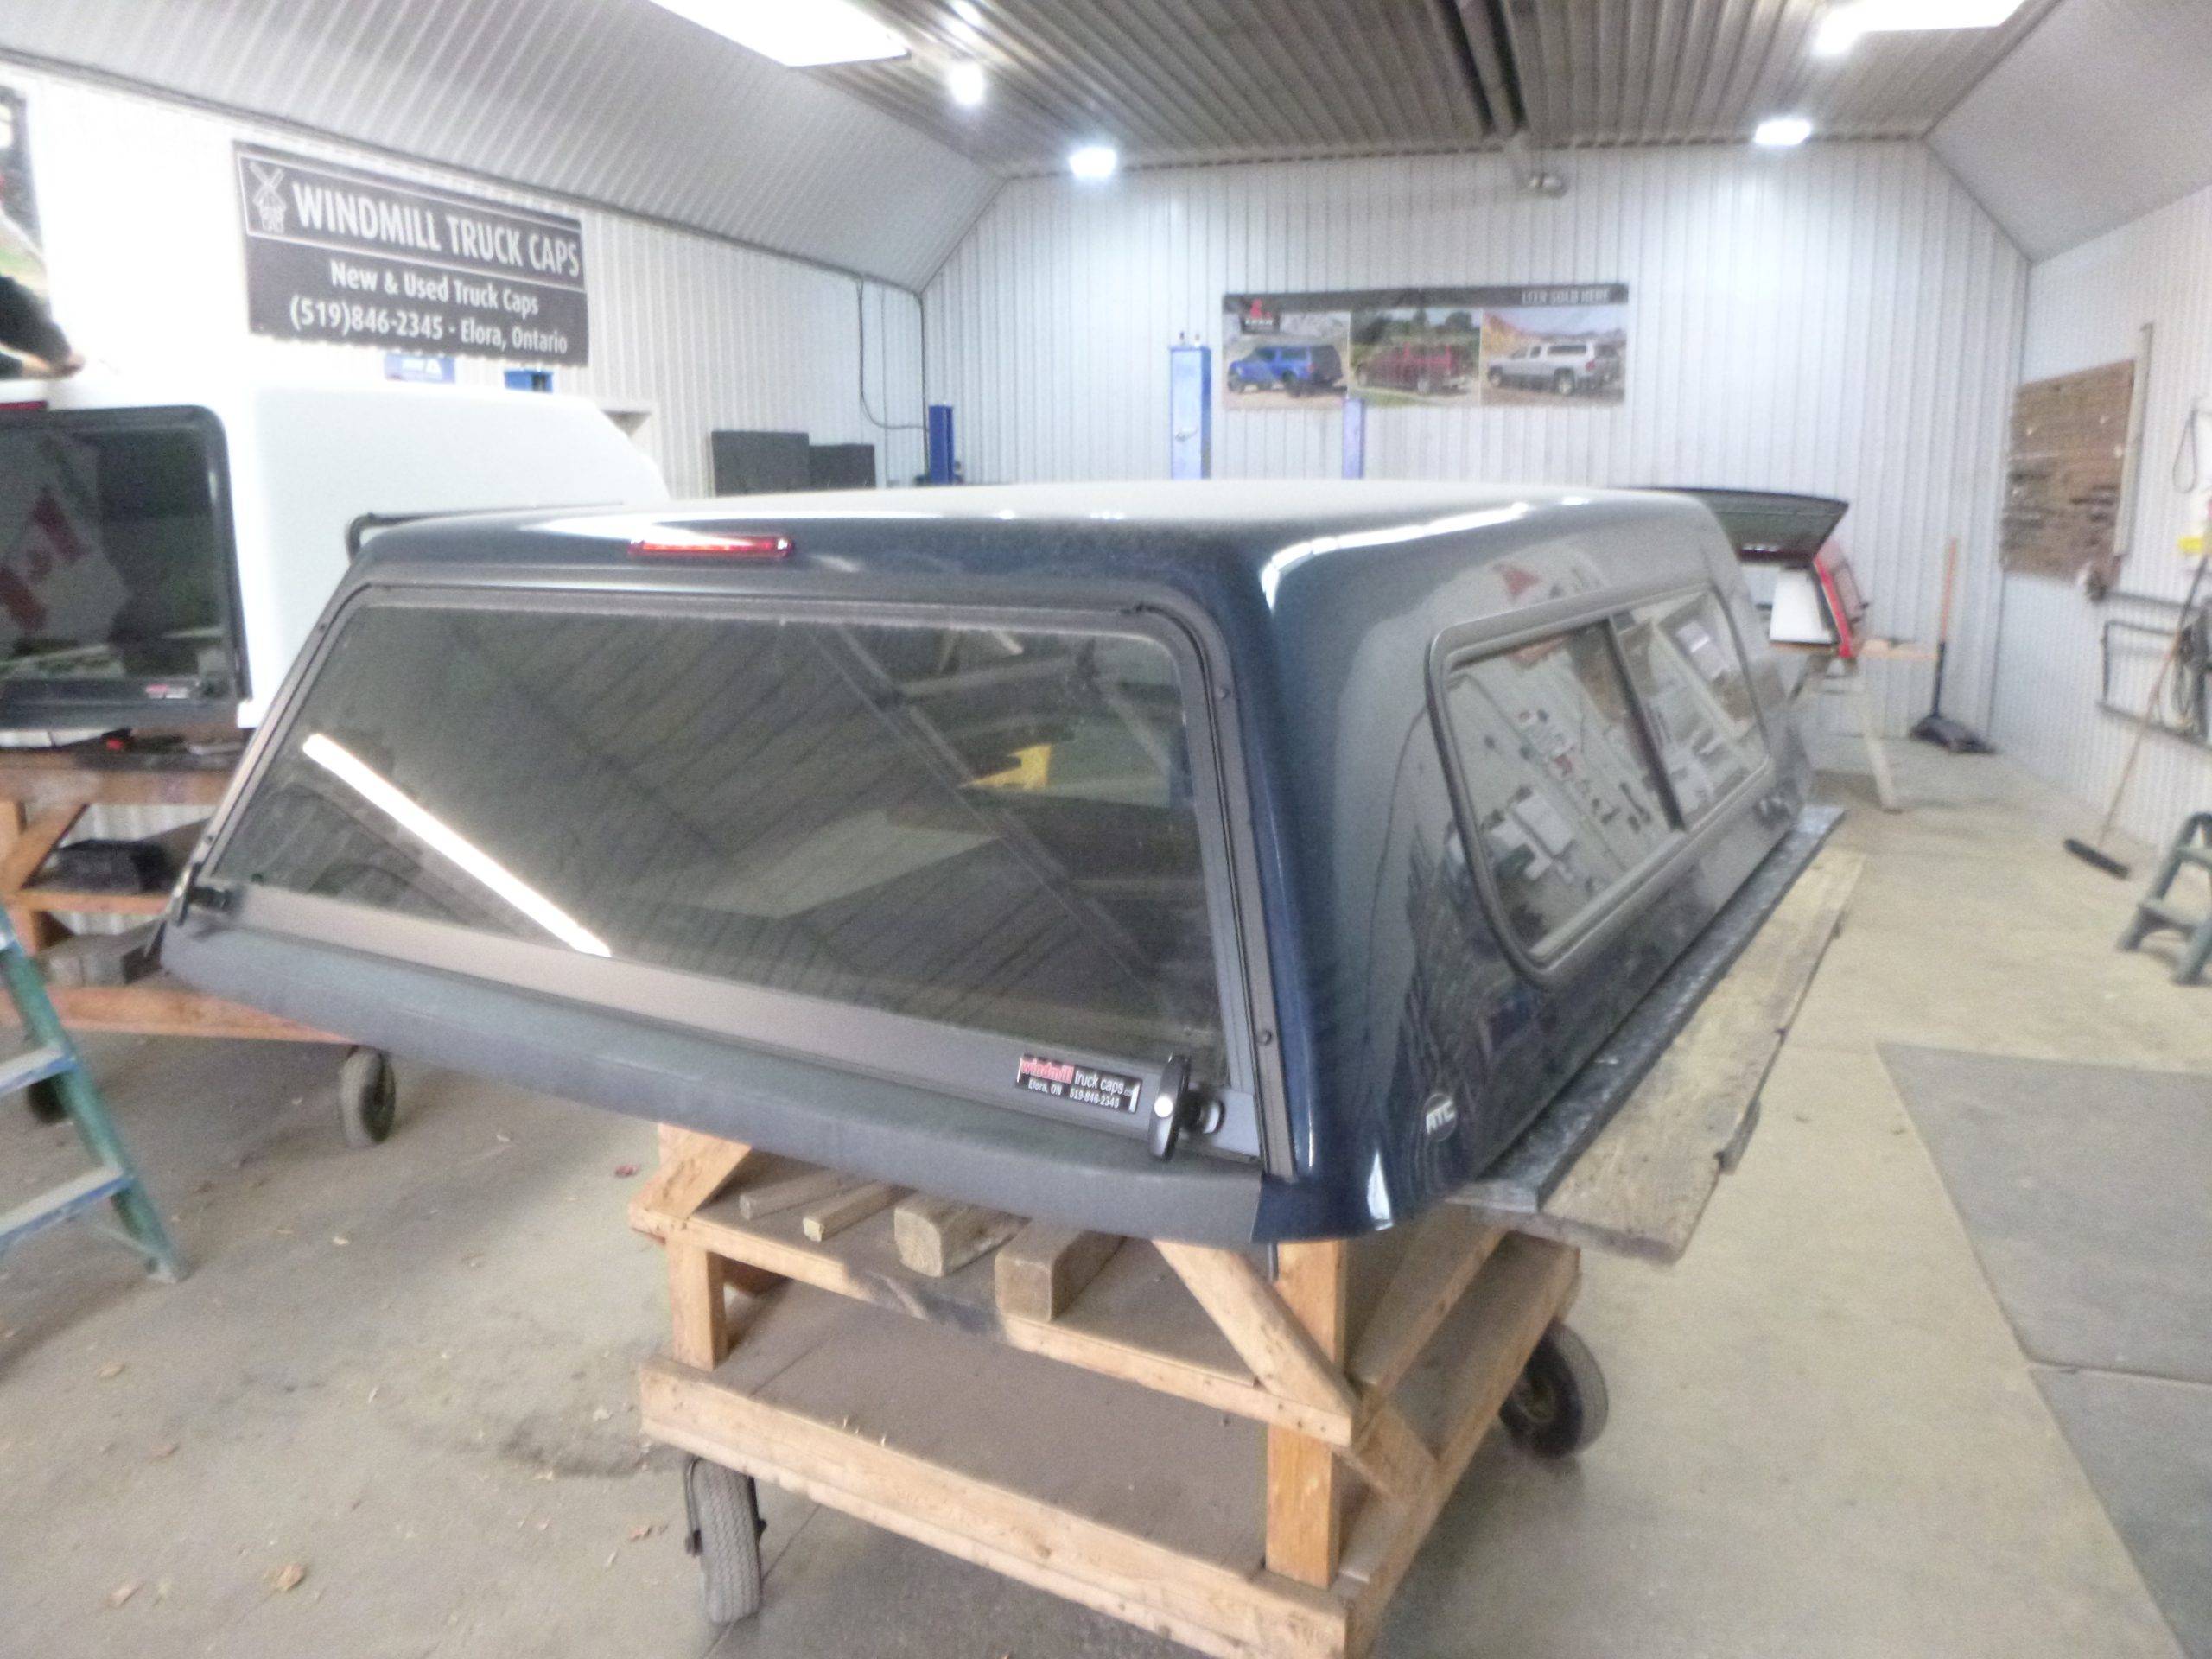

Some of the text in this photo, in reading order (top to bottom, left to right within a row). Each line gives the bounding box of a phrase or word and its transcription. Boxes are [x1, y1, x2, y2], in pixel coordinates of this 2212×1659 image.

[292, 182, 580, 277] WINDMILL TRUCK CAPS
[330, 259, 539, 320] New & Used Truck Caps
[290, 294, 443, 340] (519)846-2345
[460, 316, 506, 351] Elora,
[512, 324, 568, 354] Ontario
[1020, 1058, 1074, 1084] windmill
[1074, 1070, 1099, 1089] truck
[1050, 1083, 1063, 1096] ON
